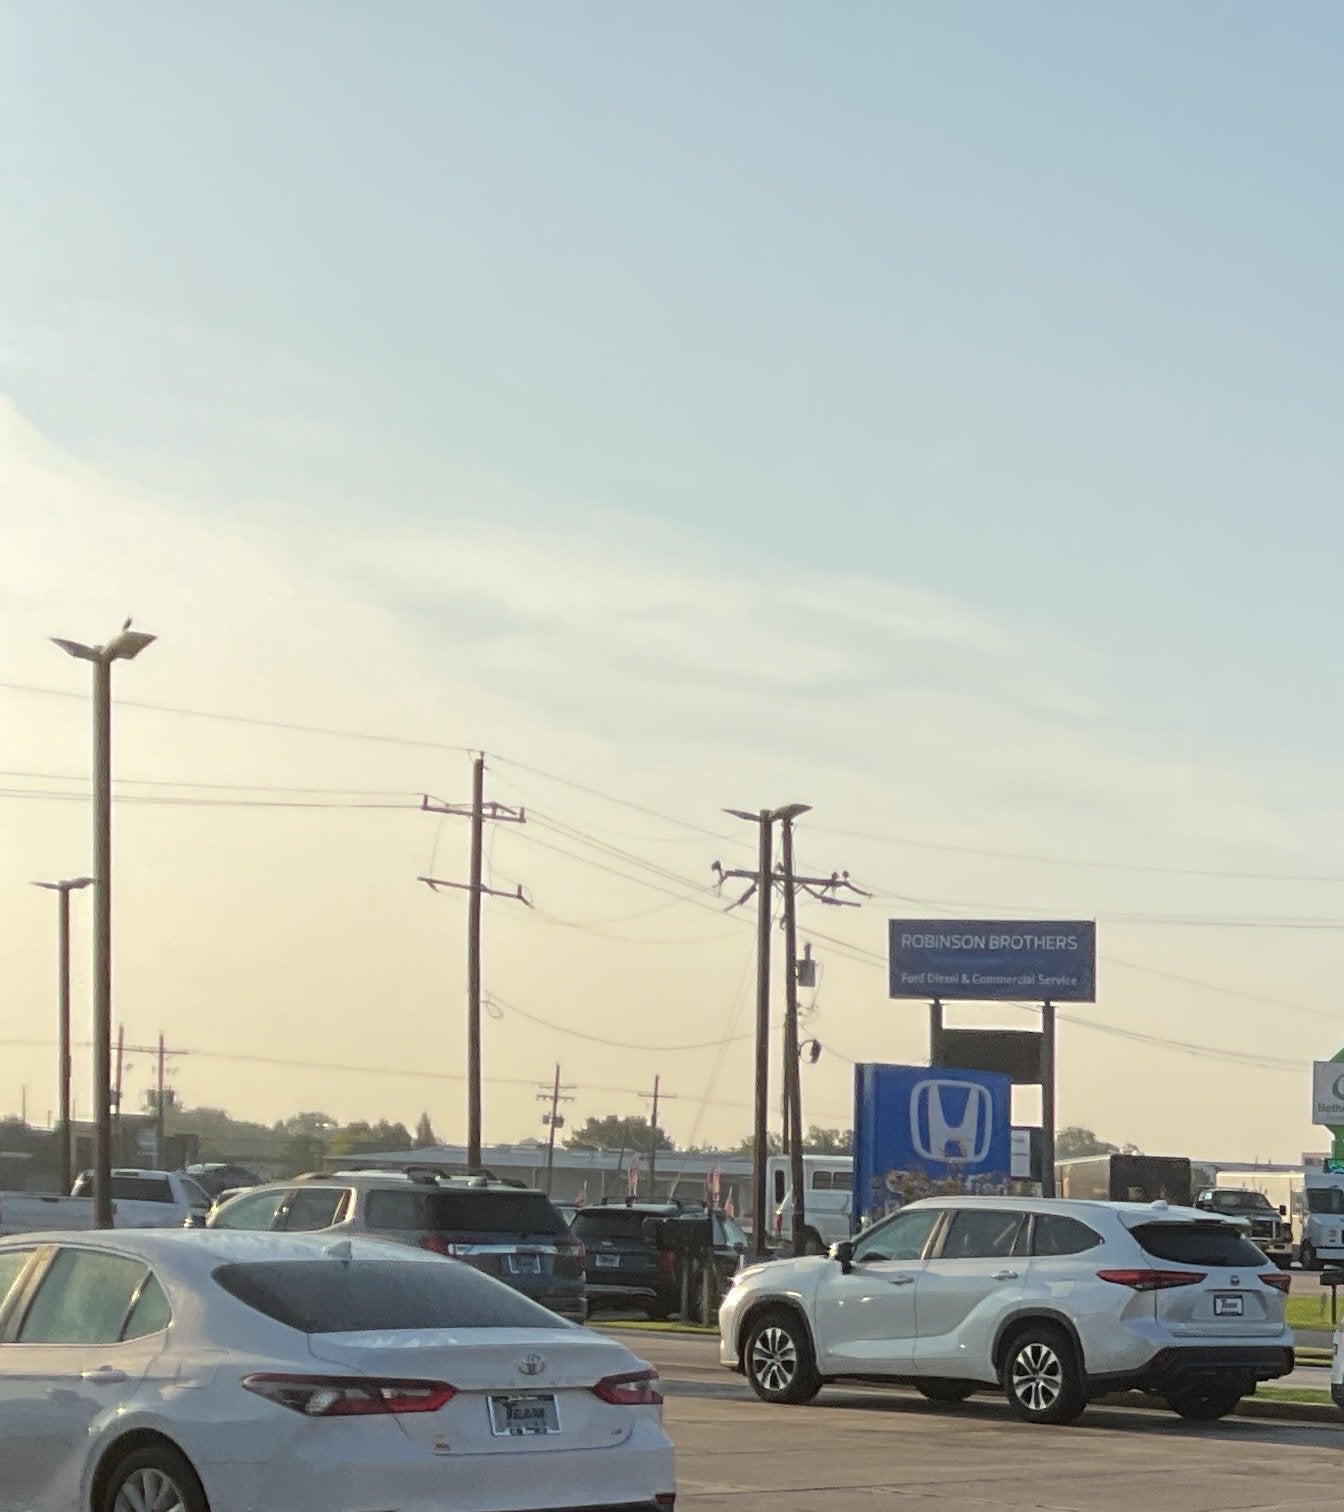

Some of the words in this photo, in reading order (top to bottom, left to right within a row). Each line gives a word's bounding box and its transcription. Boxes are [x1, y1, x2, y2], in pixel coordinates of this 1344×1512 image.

[901, 933, 986, 950] ROBINSON
[988, 934, 1079, 951] BROTHERS
[901, 971, 925, 984] Ford
[927, 972, 959, 985] Diesel
[961, 973, 970, 985] &
[972, 973, 1035, 986] Commercial
[1037, 973, 1078, 987] Service
